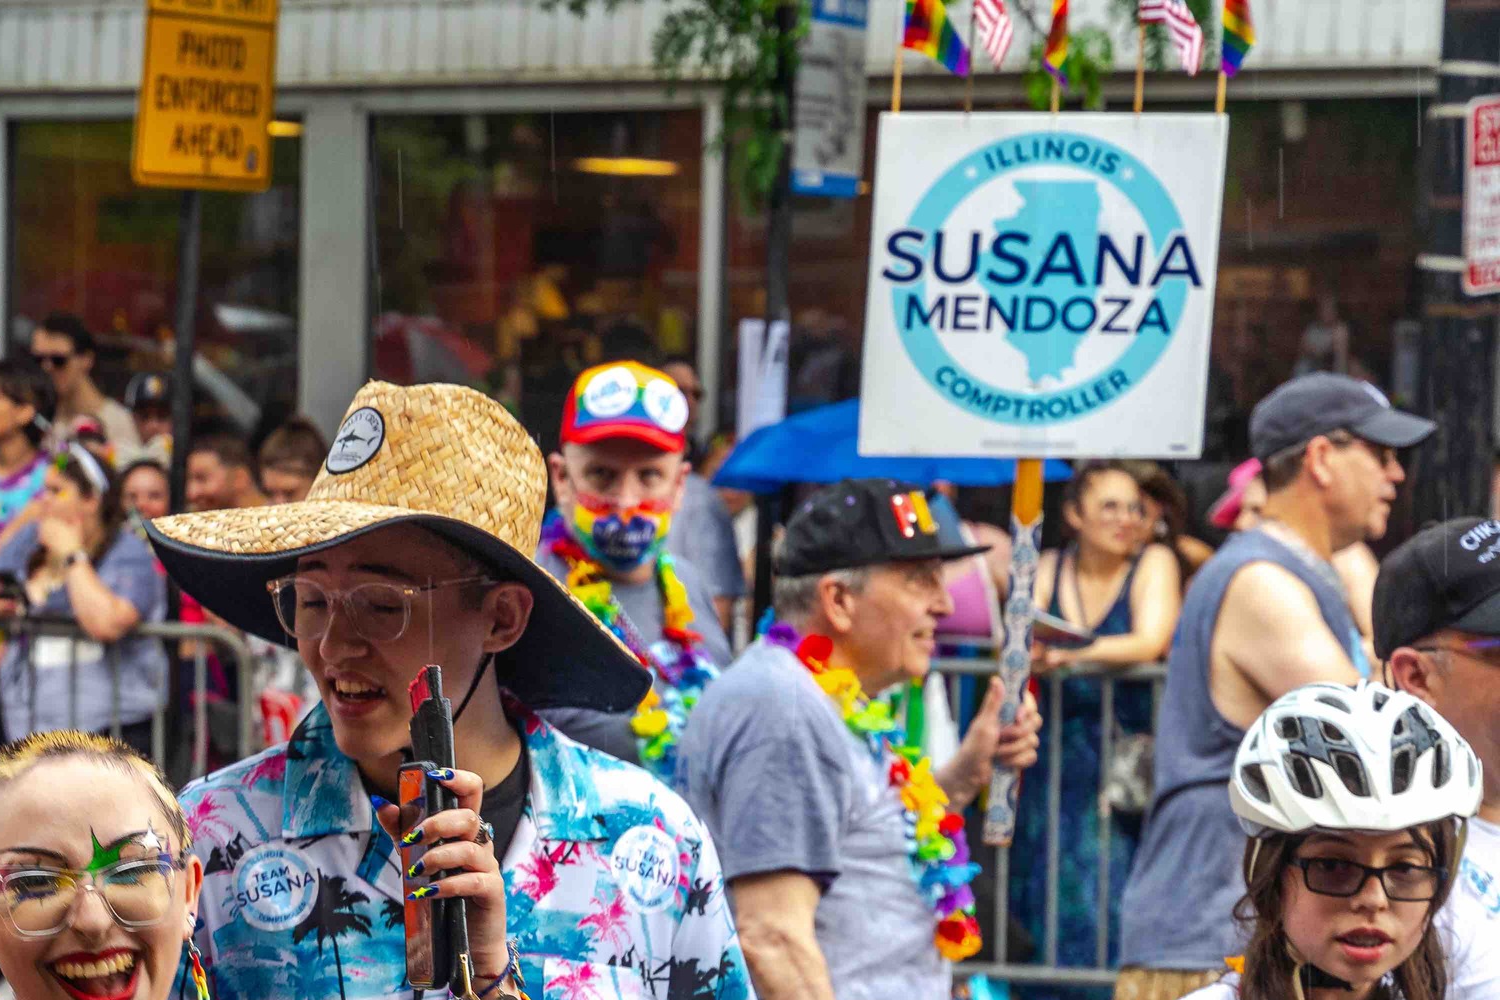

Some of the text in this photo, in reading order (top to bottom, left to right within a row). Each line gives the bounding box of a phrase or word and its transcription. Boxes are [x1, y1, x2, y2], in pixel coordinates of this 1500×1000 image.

[176, 30, 247, 71] PHOTO
[156, 74, 261, 119] ENFORCED
[169, 122, 244, 161] AHEAD
[984, 139, 1122, 175] ILLINOIS
[881, 230, 1202, 287] SUSANA
[904, 294, 1171, 335] MENDOZA
[935, 366, 1130, 421] COMPTROLLER
[237, 870, 315, 908] SUSANA
[252, 865, 290, 883] TEAM
[614, 855, 677, 889] SUSANA
